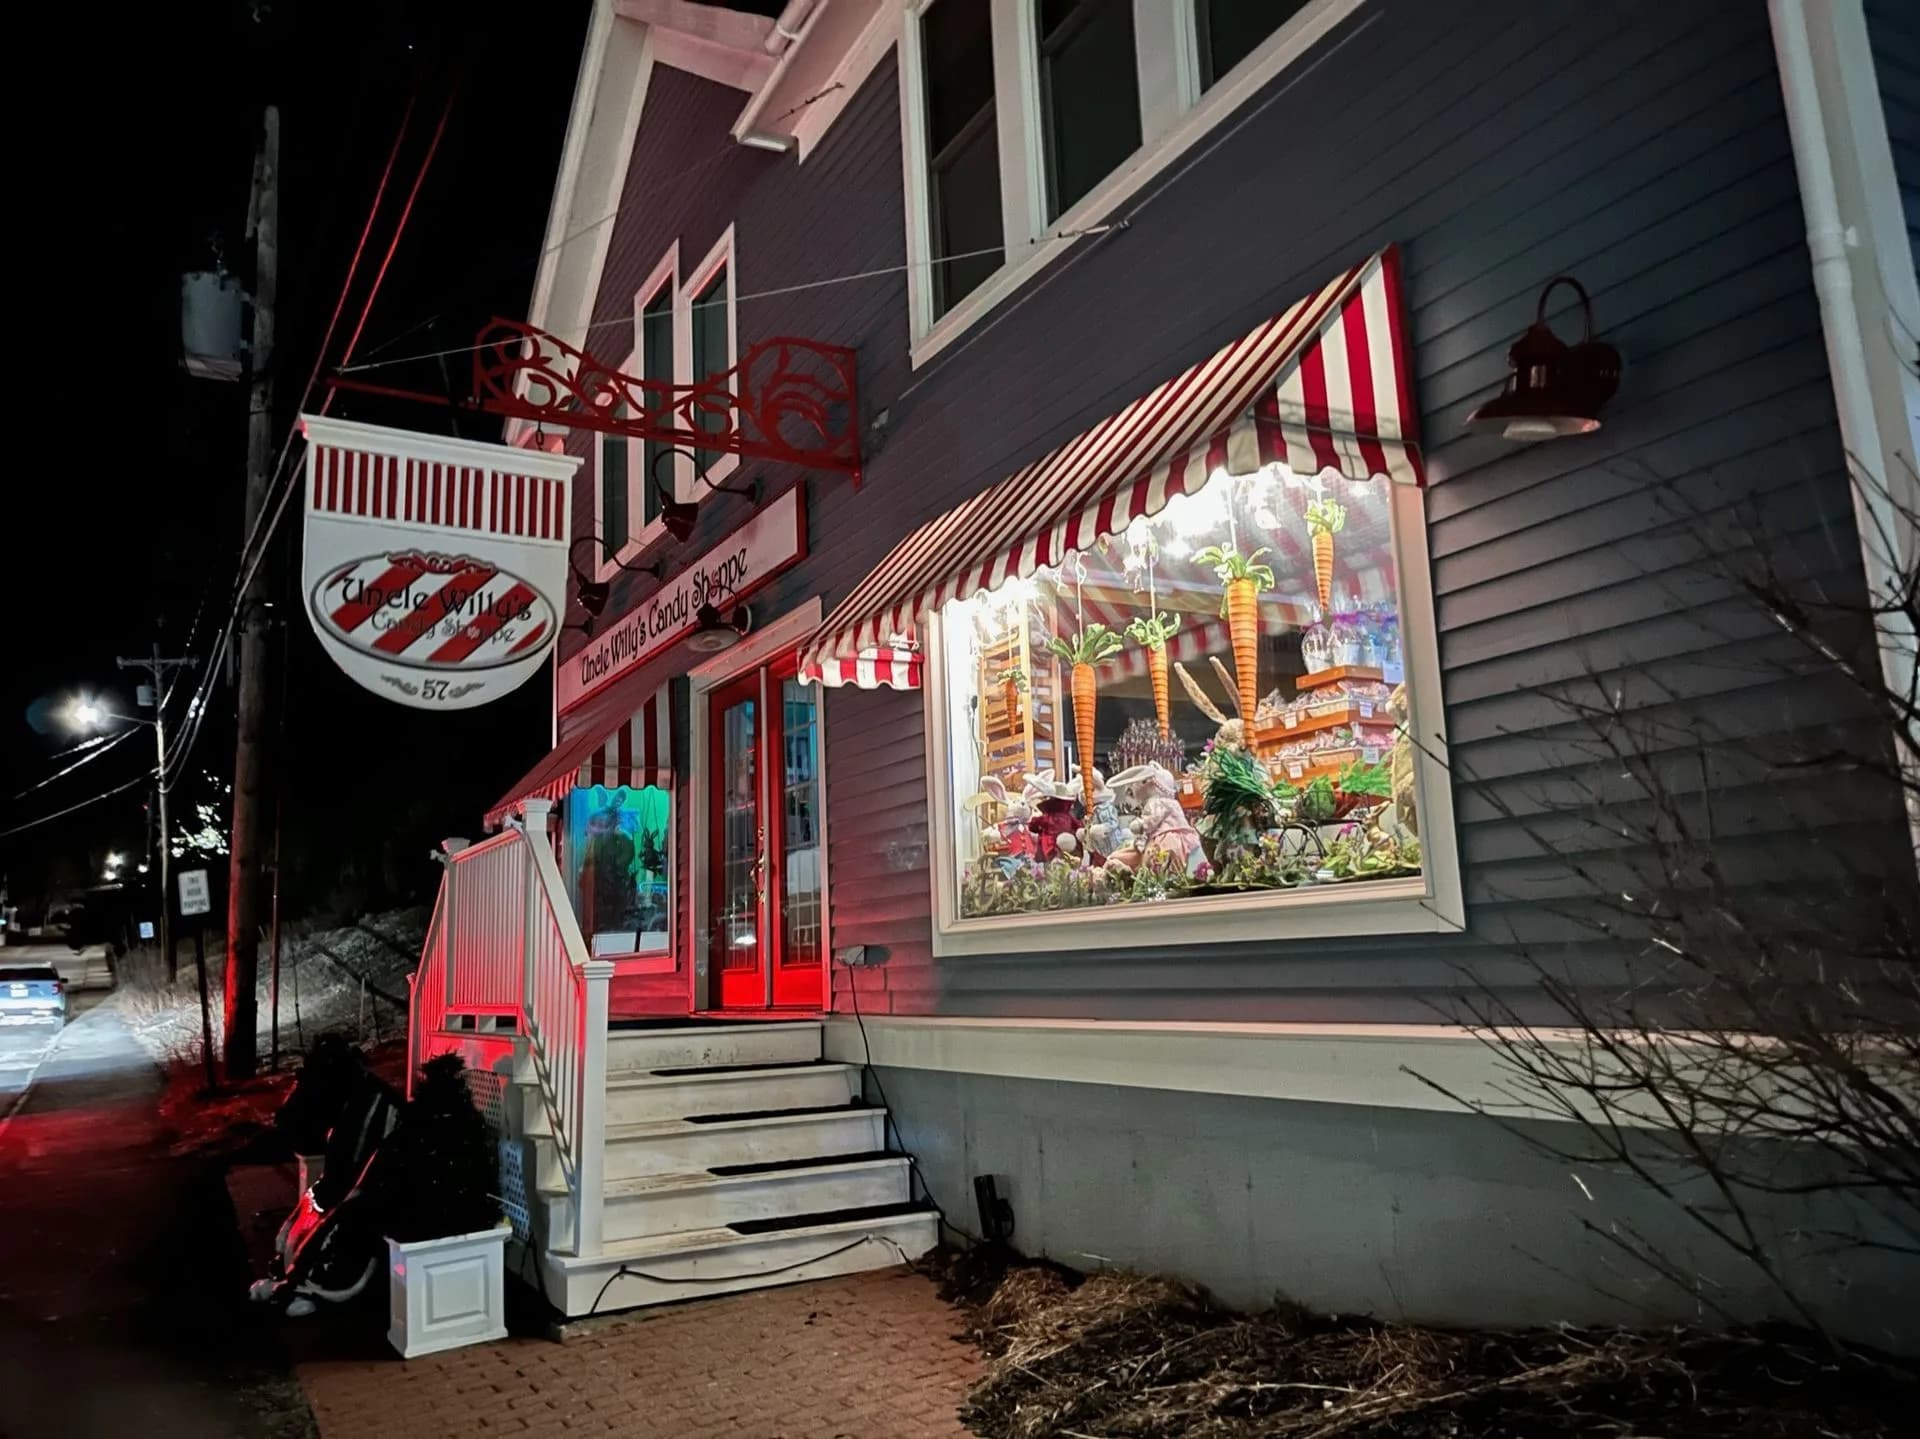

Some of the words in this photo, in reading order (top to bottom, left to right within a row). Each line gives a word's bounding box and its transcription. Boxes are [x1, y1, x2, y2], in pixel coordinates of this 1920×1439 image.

[341, 577, 430, 610] Uncle
[439, 588, 532, 622] Willy's
[582, 643, 610, 686] Uncle
[611, 615, 647, 667] Willy's
[649, 584, 688, 639] Candy
[691, 547, 748, 609] Shoppe
[371, 611, 436, 640] Candy
[422, 678, 450, 701] 57
